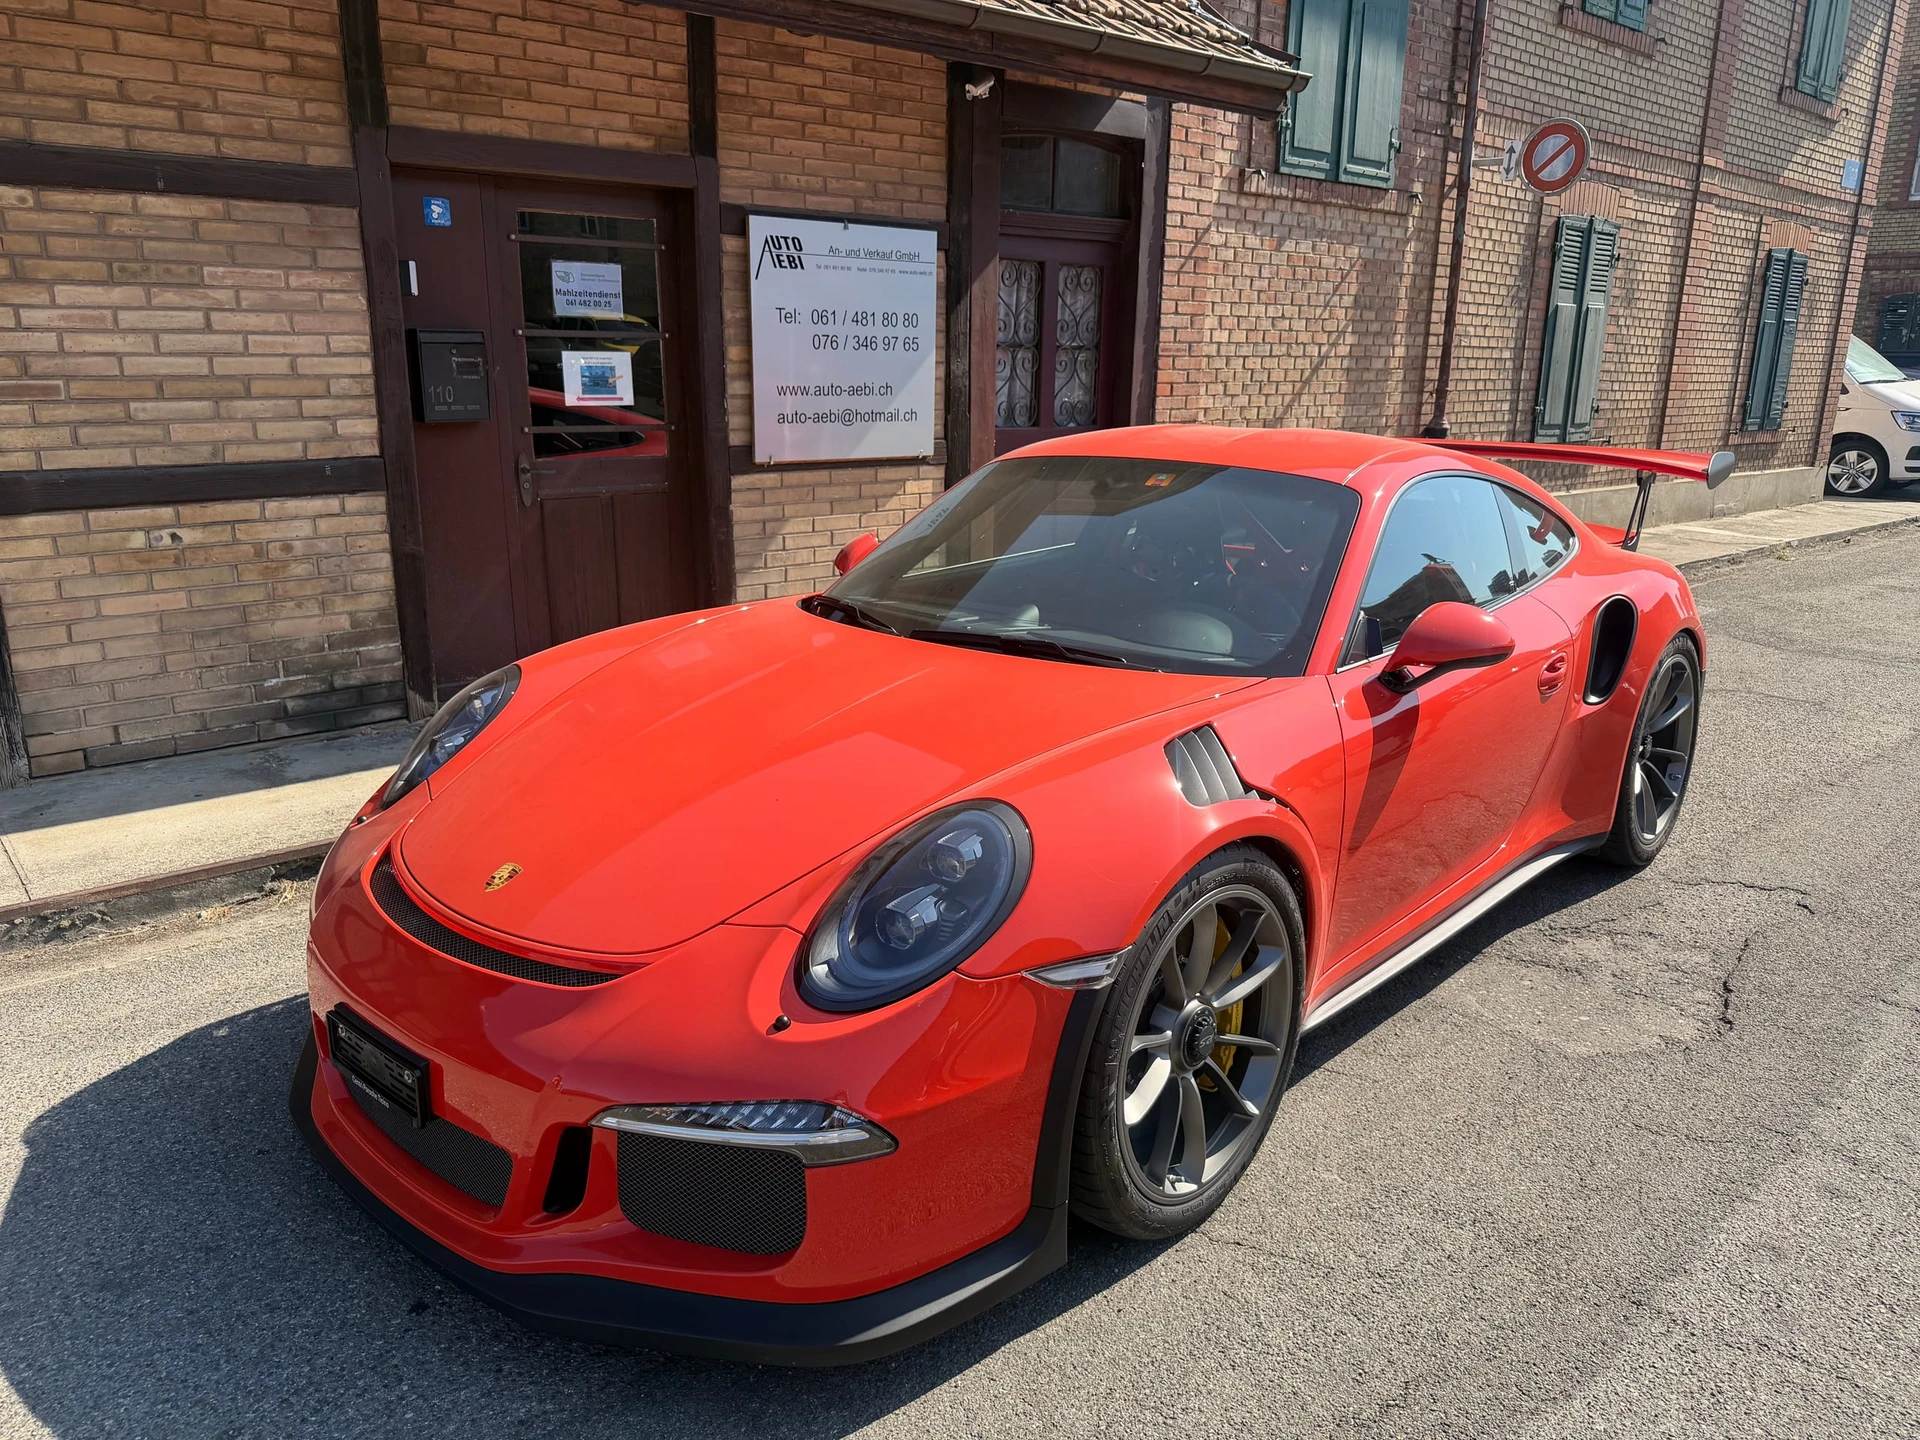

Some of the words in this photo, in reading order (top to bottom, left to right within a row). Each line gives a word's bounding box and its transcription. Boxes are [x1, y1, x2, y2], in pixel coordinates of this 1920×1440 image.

[828, 245, 843, 255] An-
[845, 247, 860, 257] und
[862, 248, 893, 260] Verkauf
[895, 250, 920, 261] GmbH
[555, 288, 620, 300] Mahlzeitendienst
[565, 298, 577, 307] 061
[578, 299, 592, 308] 482
[593, 300, 602, 308] 00
[603, 300, 612, 308] 25
[775, 307, 801, 325] Tel:
[811, 309, 837, 326] 061
[842, 310, 848, 326] /
[851, 310, 876, 327] 481
[881, 311, 898, 329] 80
[902, 312, 919, 329] 80
[812, 334, 839, 351] 076
[843, 334, 849, 351] /
[852, 335, 878, 351] 346
[882, 335, 899, 352] 97
[903, 336, 919, 352] 65
[428, 385, 454, 403] 110
[776, 381, 893, 397] www.auto-aebi.ch
[777, 408, 918, 427] auto-aebi@hotmail.ch
